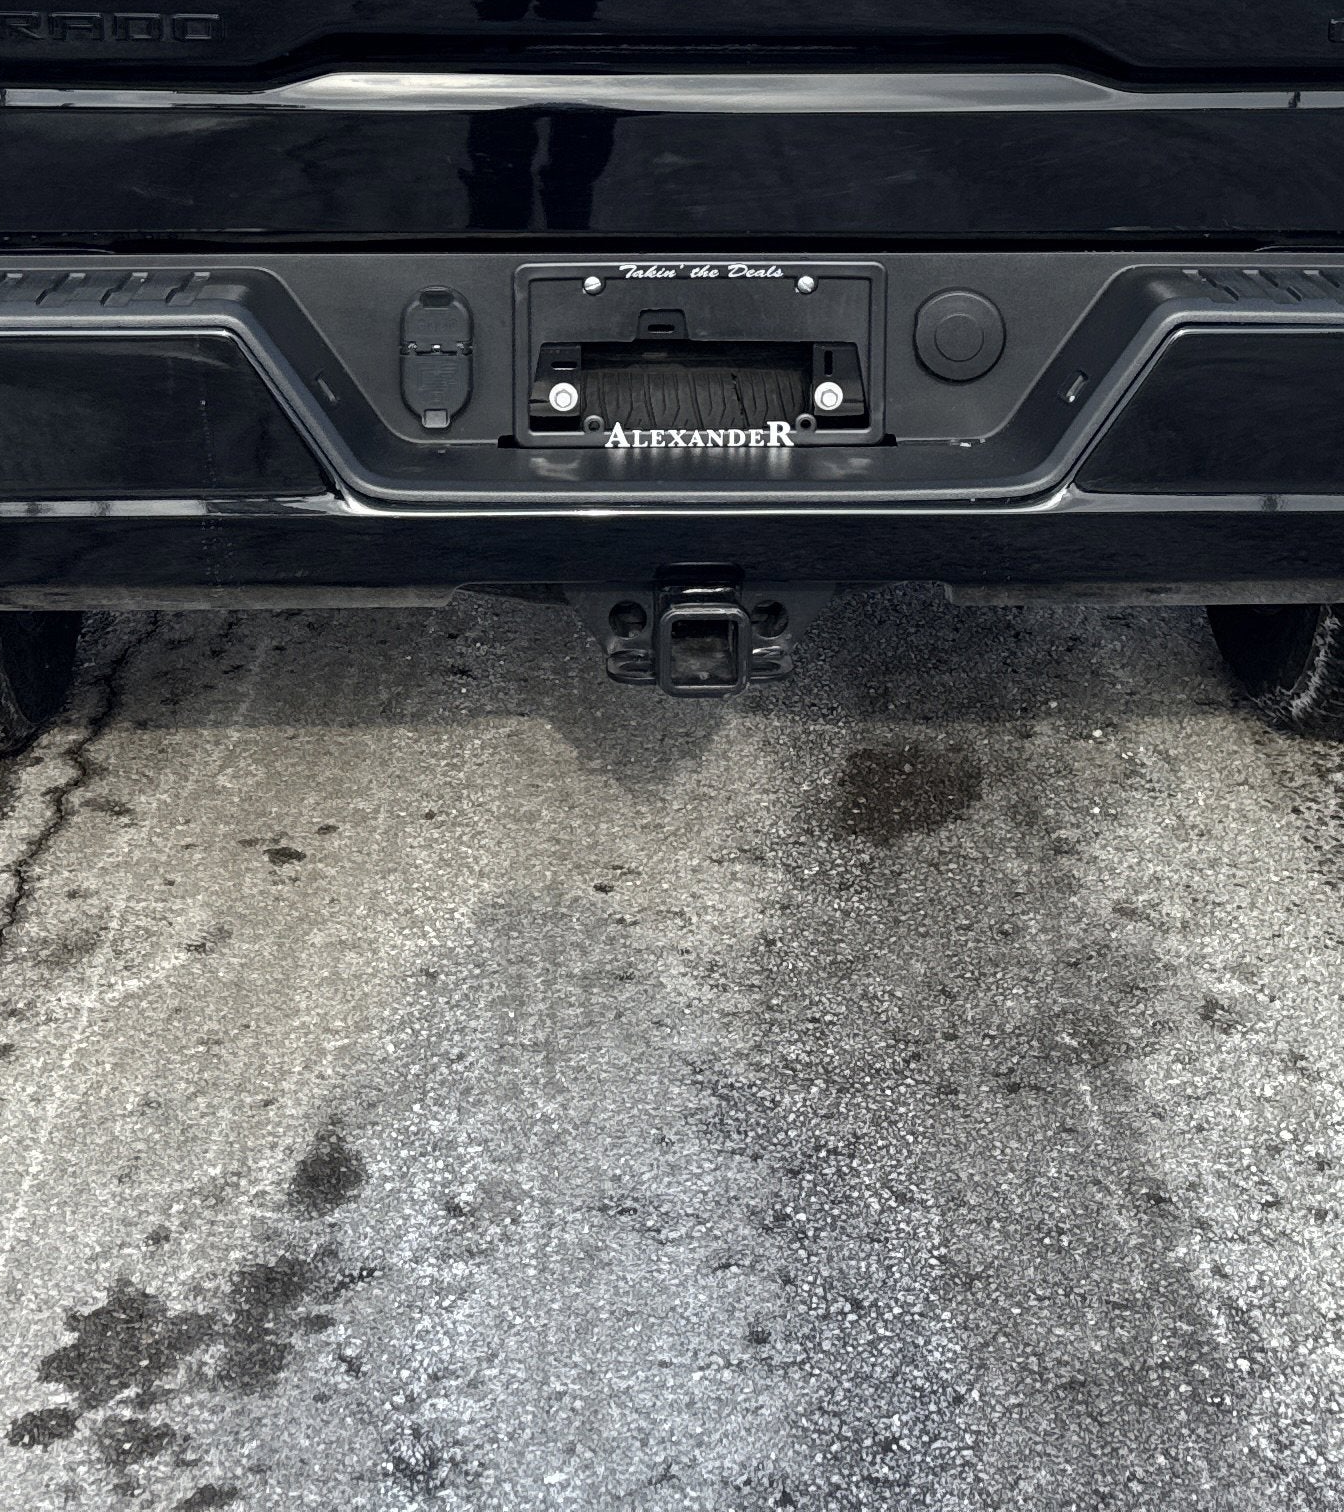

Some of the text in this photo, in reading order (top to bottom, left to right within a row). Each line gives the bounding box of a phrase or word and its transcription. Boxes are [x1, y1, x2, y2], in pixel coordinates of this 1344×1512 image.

[690, 264, 720, 278] the
[728, 263, 784, 278] Deals
[604, 420, 795, 448] ALEXANDER
